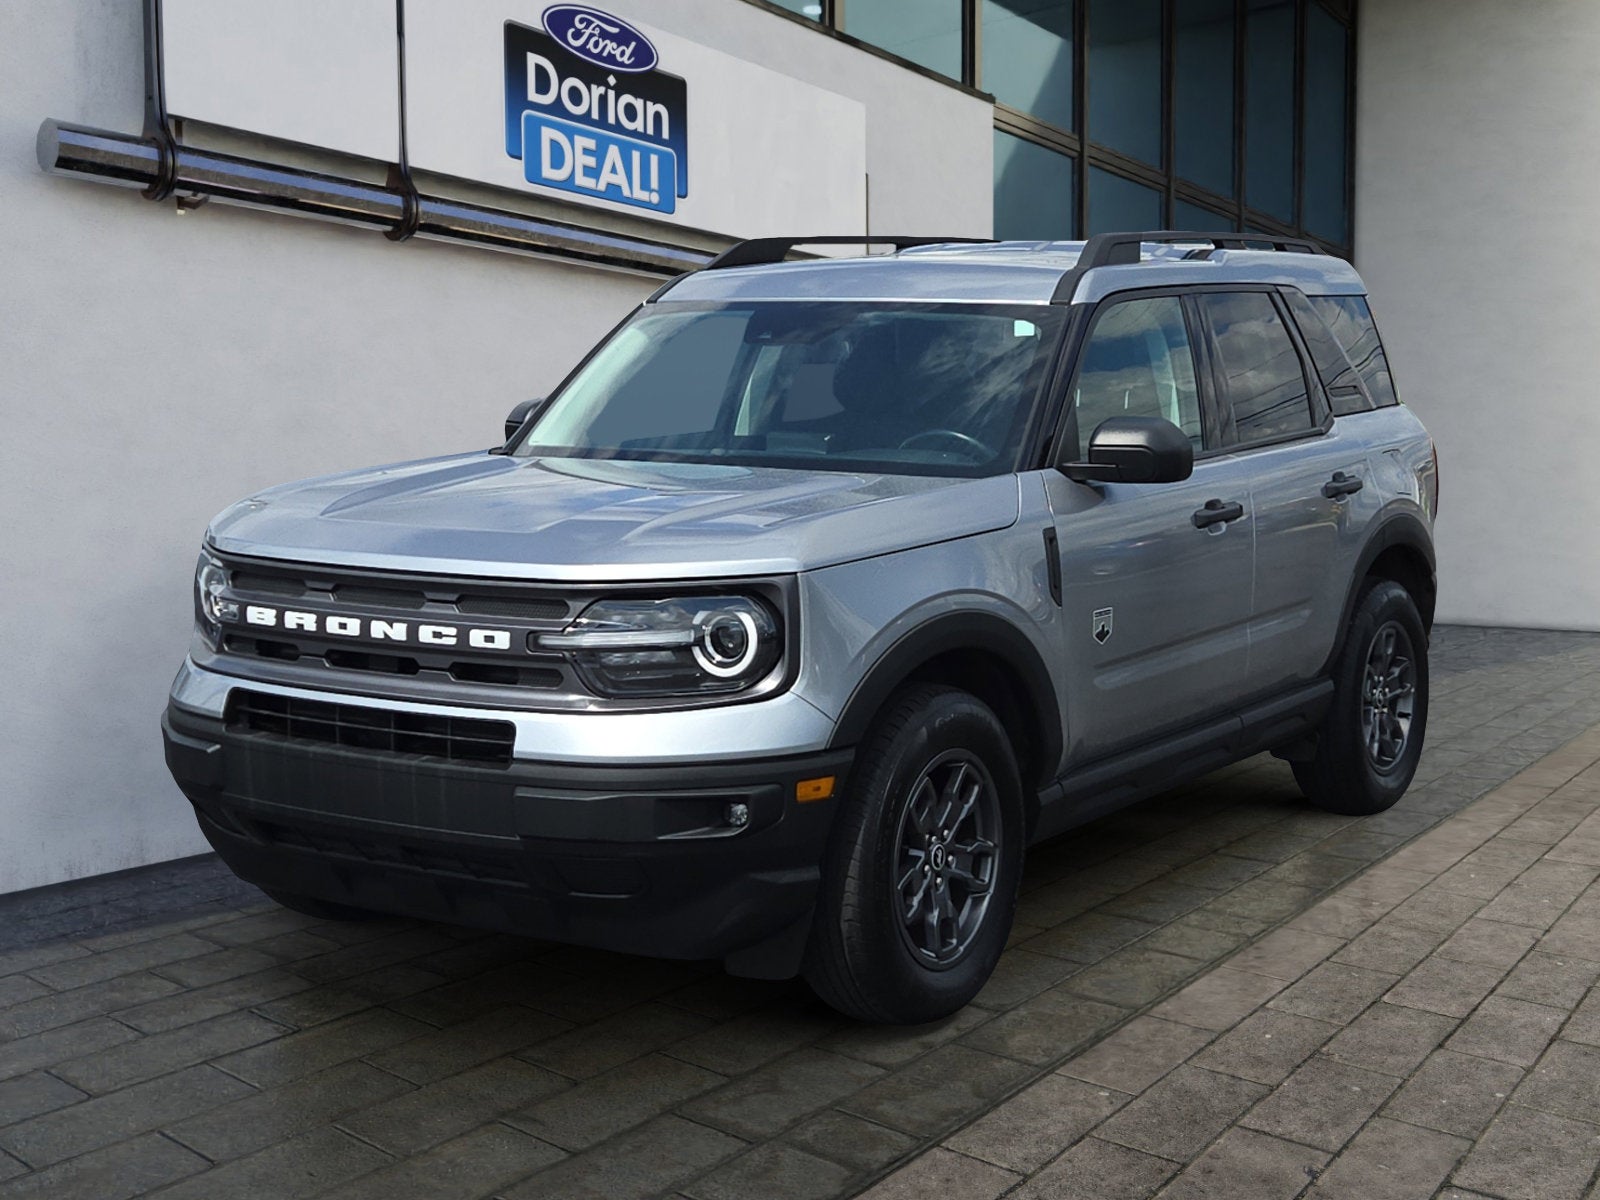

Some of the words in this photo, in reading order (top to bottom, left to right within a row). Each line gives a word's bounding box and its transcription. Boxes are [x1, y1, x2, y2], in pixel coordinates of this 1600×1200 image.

[566, 13, 637, 65] Ford
[527, 51, 670, 140] Dorian
[541, 126, 660, 205] DEAL!
[246, 605, 511, 650] BRONCO
